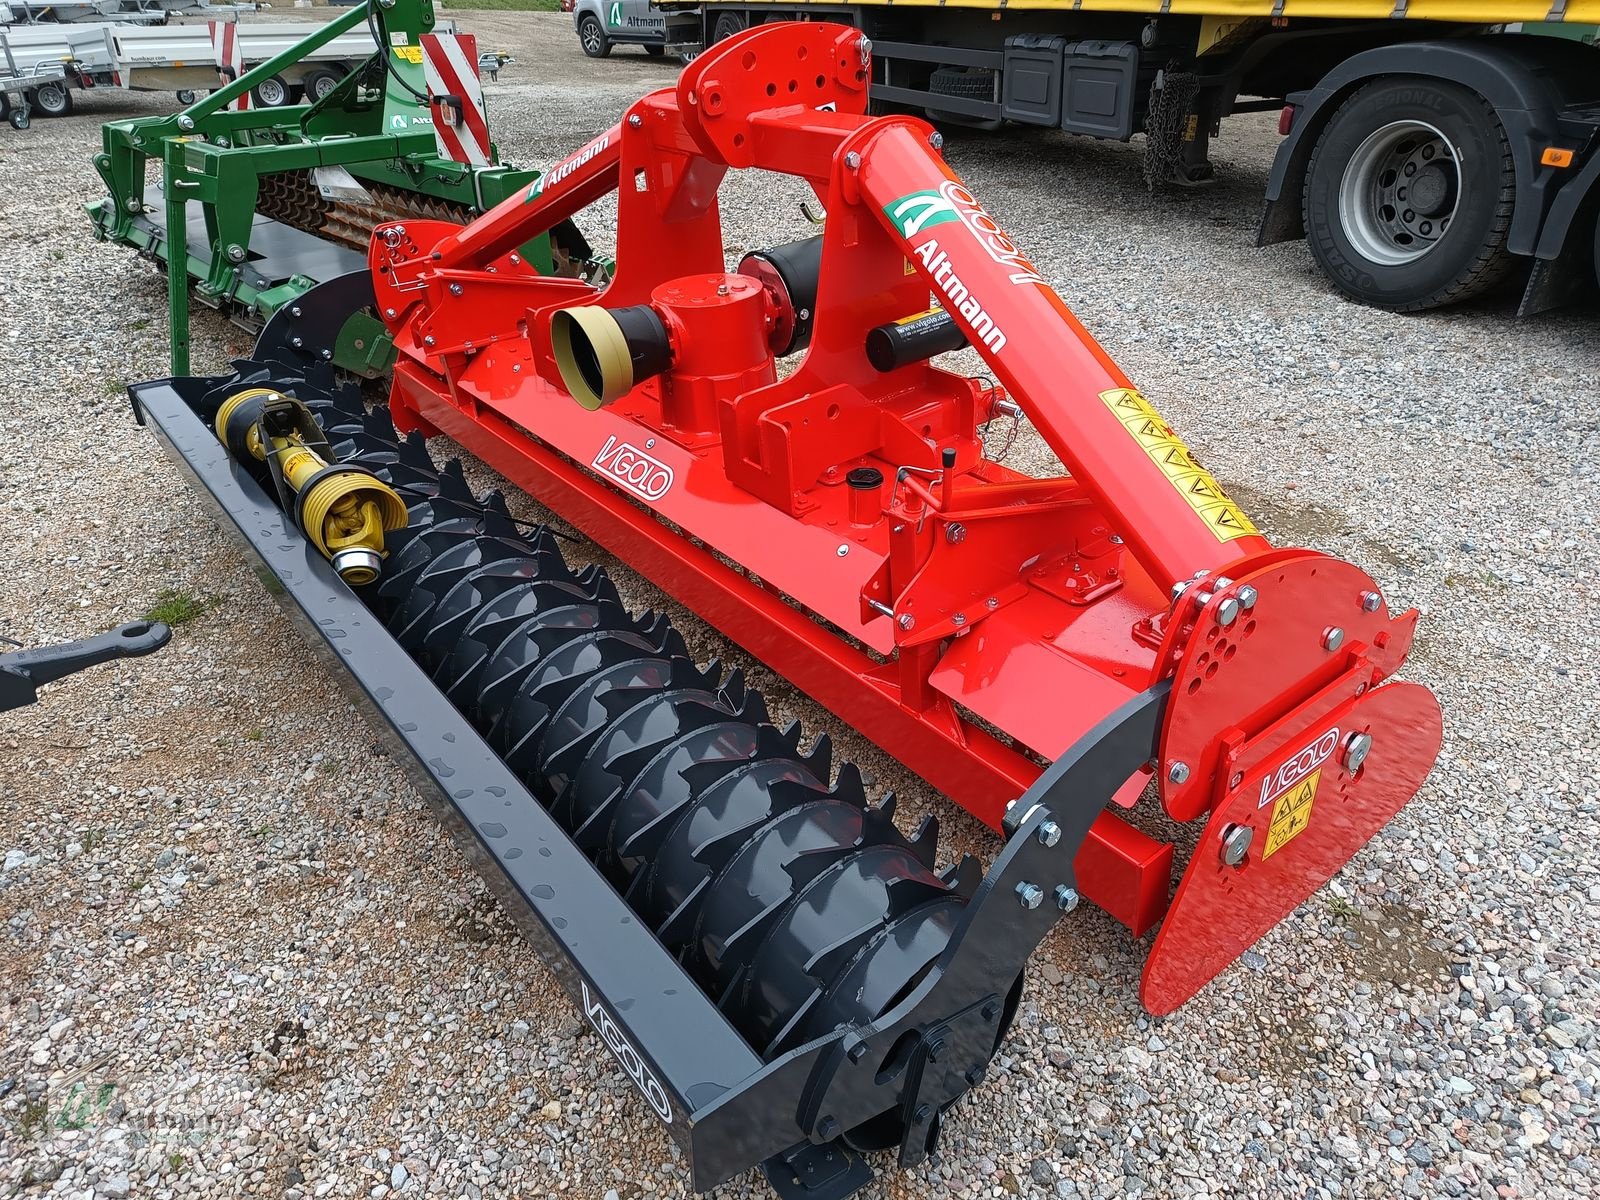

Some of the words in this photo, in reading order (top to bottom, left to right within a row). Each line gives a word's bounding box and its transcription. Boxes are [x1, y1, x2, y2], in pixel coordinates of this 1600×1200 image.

[626, 15, 664, 27] Altmann
[547, 136, 609, 189] Altmann
[913, 239, 1007, 355] Altmann
[591, 435, 674, 501] VIGOLO
[1257, 727, 1340, 810] VIGOLO
[581, 980, 673, 1124] VIGOLO
